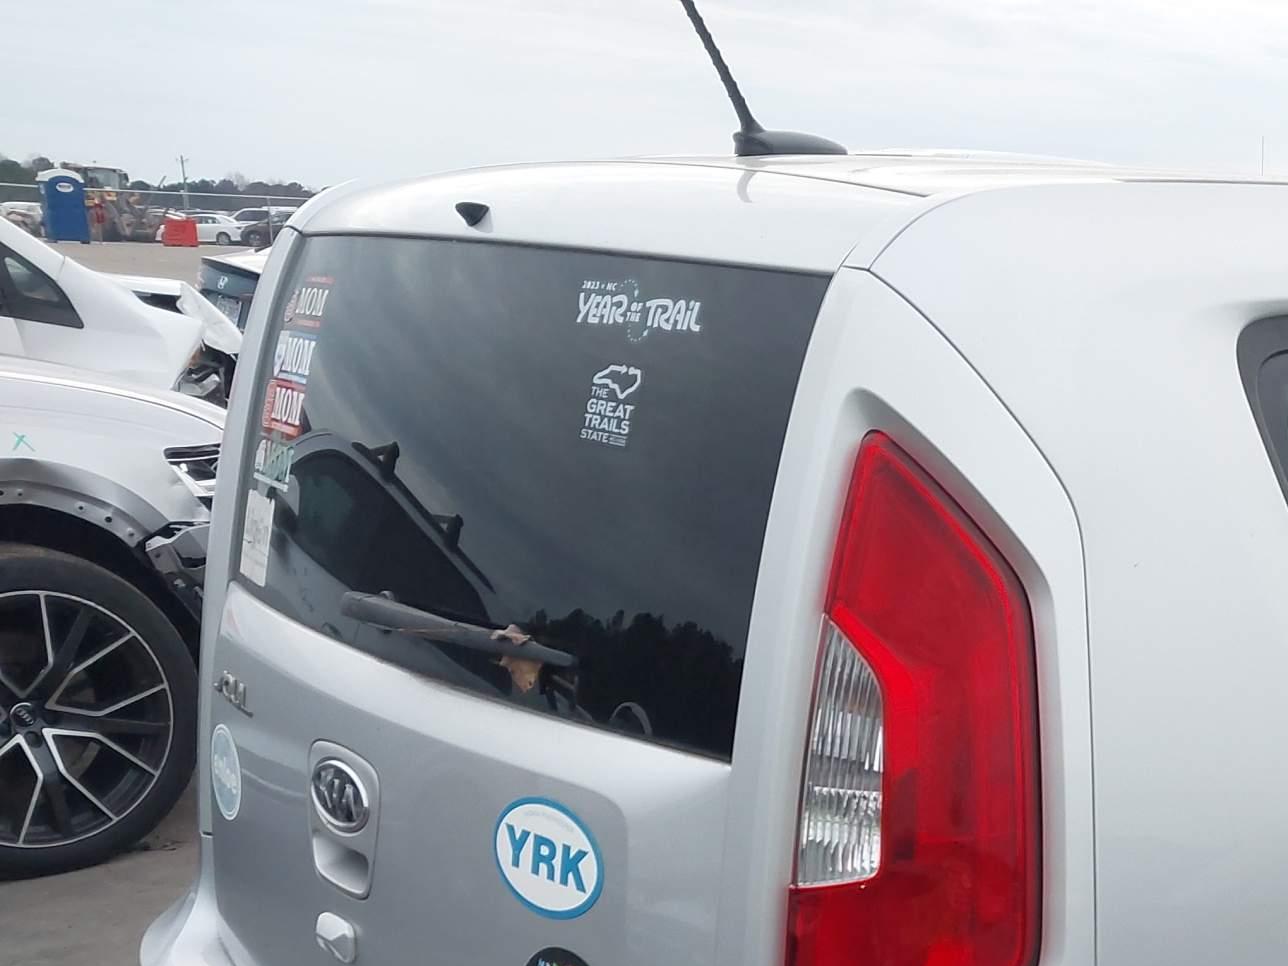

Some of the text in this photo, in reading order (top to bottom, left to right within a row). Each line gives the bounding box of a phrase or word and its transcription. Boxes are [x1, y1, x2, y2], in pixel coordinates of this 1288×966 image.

[296, 287, 329, 317] MOM
[576, 292, 628, 324] YEAR
[630, 302, 643, 313] OF
[282, 337, 317, 375] MOM
[271, 387, 306, 426] MOM
[591, 386, 609, 398] THE
[584, 413, 630, 435] TRAILS
[586, 399, 635, 420] GREAT
[580, 428, 609, 443] STATE
[505, 822, 590, 894] YRK
